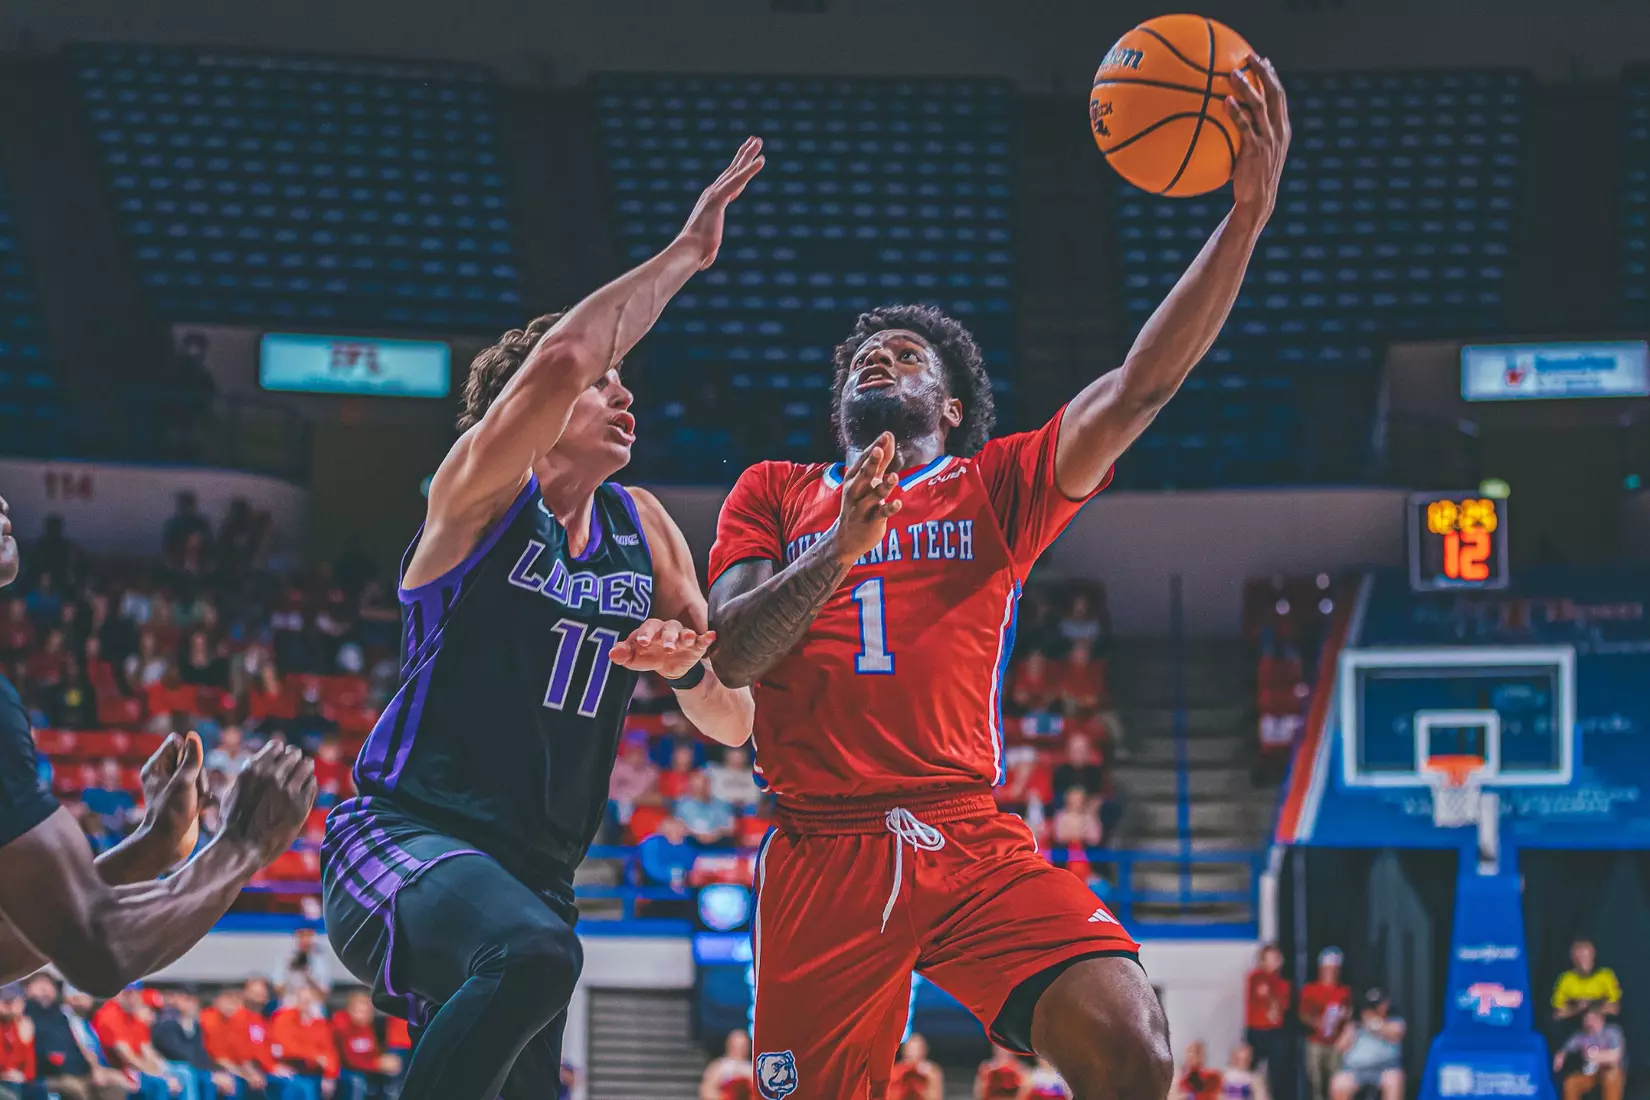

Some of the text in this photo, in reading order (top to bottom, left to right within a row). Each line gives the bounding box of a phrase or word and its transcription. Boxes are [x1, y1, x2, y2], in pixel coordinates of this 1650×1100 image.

[508, 539, 652, 621] LOPES
[908, 519, 974, 561] TECH
[1443, 527, 1491, 581] 12
[852, 576, 896, 675] 1
[543, 617, 620, 719] 11
